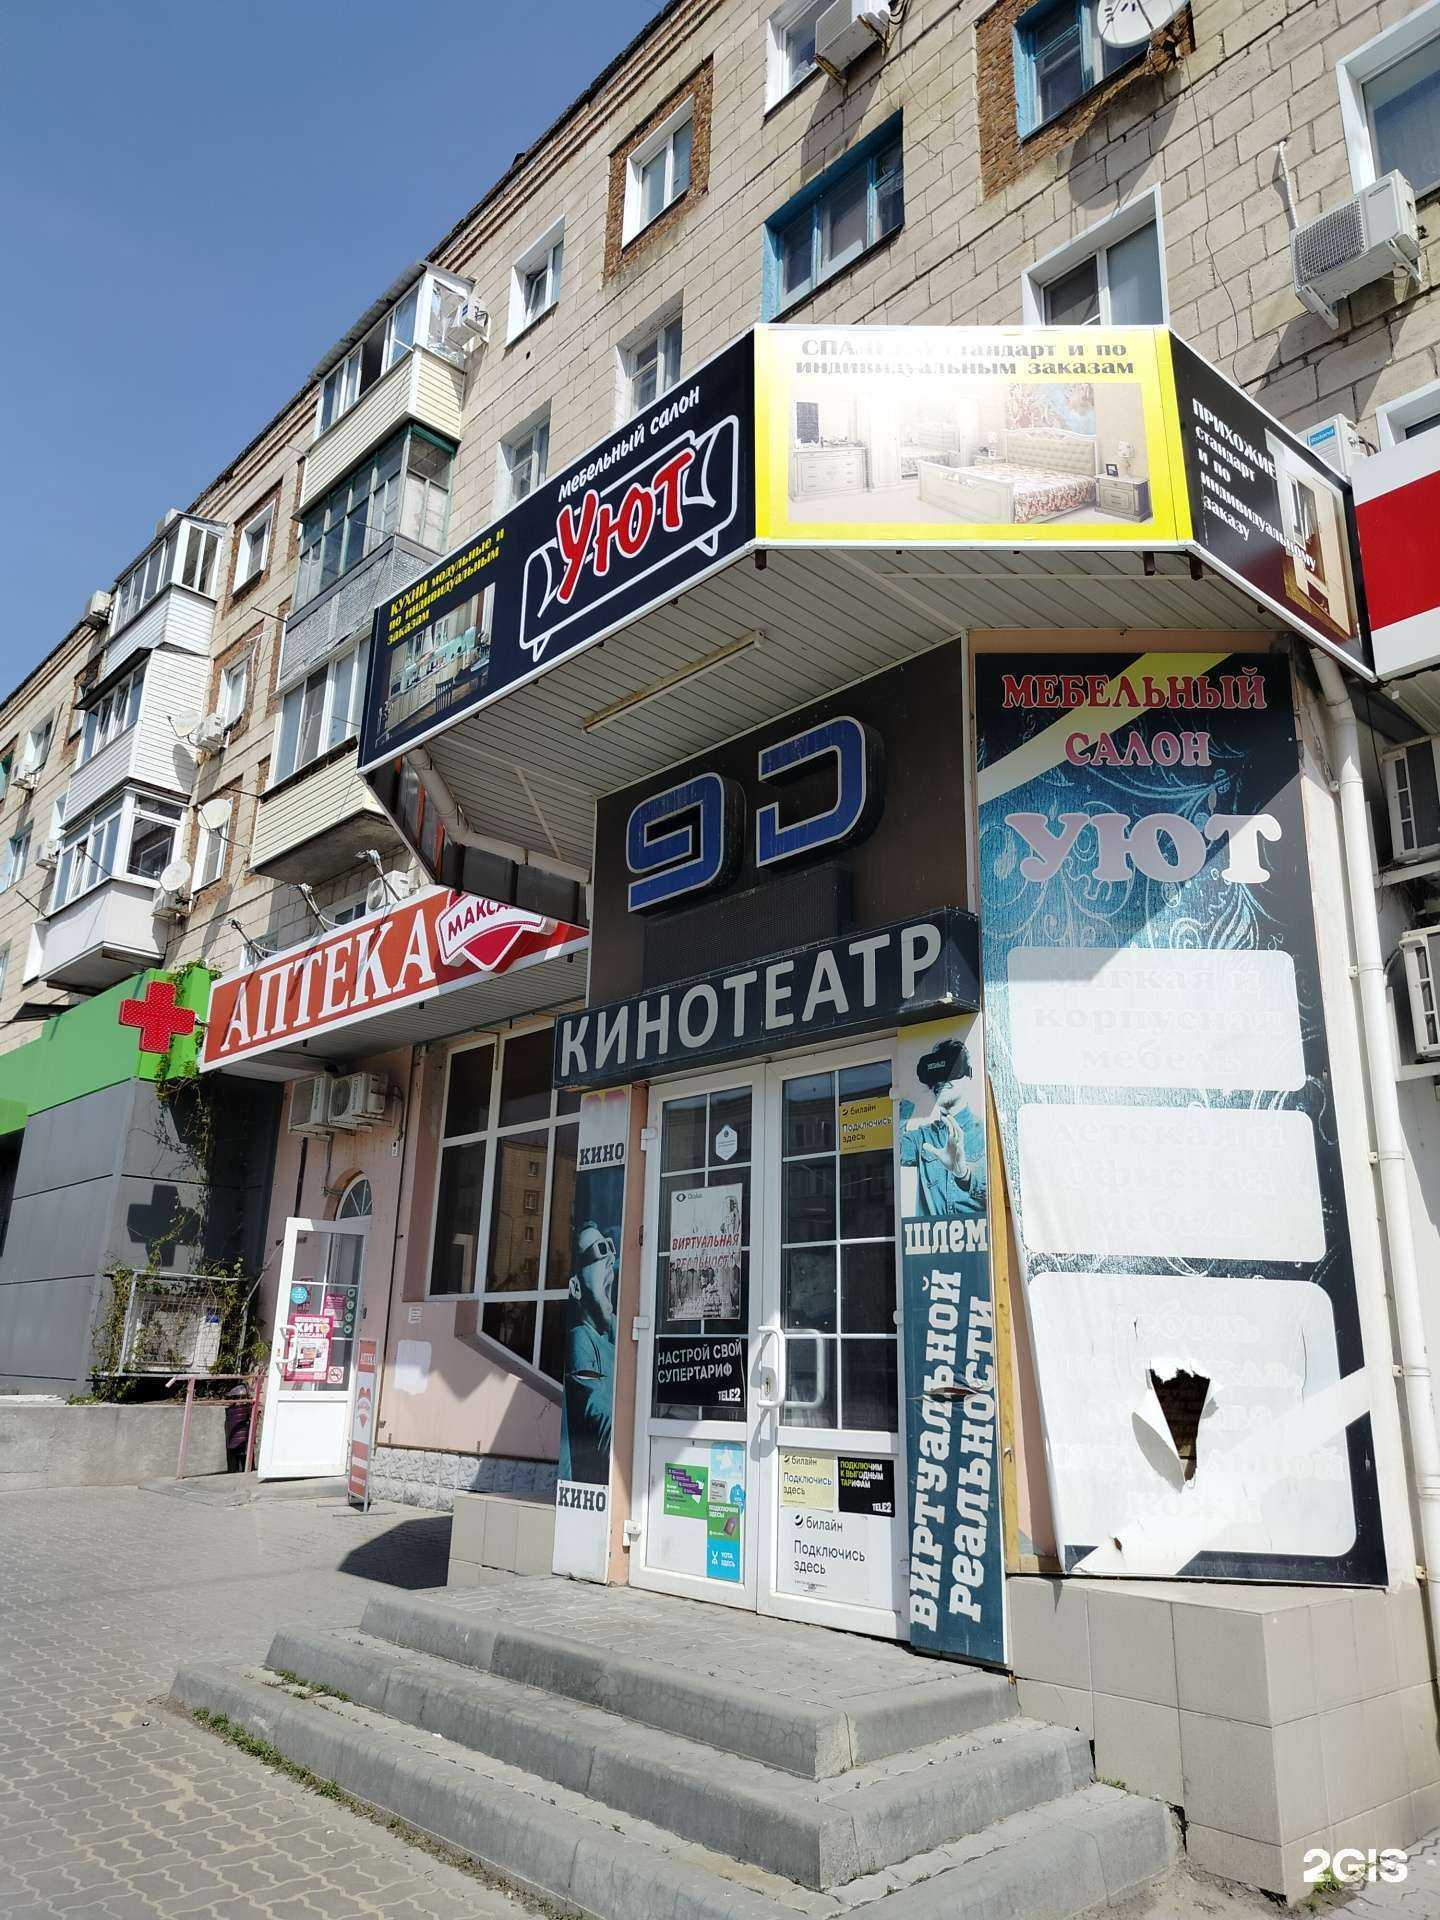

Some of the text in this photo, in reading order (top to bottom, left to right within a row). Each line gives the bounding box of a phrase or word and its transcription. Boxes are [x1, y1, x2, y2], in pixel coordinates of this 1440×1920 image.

[1067, 343, 1085, 356] и
[1096, 343, 1127, 357] по
[1028, 360, 1134, 375] заказам
[650, 386, 700, 435] салон
[1192, 398, 1277, 480] ПРИХОЖИЕ
[1195, 425, 1256, 482] стандарт
[1212, 459, 1231, 483] по
[1201, 472, 1316, 572] индивидуальному
[1203, 496, 1250, 543] заказу
[391, 528, 505, 617] КУХНИ модульные и
[389, 546, 500, 632] по индивидуальным
[387, 609, 430, 645] заказам
[1001, 667, 1267, 709] МЕБЕЛЬНЫЙ
[1064, 731, 1211, 766] САЛОН
[1005, 812, 1282, 884] УЮТ
[220, 908, 437, 1052] АПТЕКА
[560, 923, 942, 1077] КИНОТЕАТР
[1033, 1008, 1283, 1038] корпусная
[1080, 1037, 1243, 1072] мебель
[842, 1116, 892, 1133] Подключись
[842, 1133, 866, 1144] здесь
[579, 1142, 625, 1166] КИНО
[672, 1233, 740, 1251] ВИРТУАЛЬНАЯ
[657, 1338, 743, 1366] НАСТРОЙ СВОЙ
[657, 1362, 732, 1383] СУПЕРТАРИФ
[718, 1388, 741, 1401] TELE2
[792, 1456, 817, 1466] билайн
[840, 1460, 883, 1472] ПОДКЛЮЧИМ
[783, 1472, 832, 1487] Подключись
[841, 1478, 871, 1489] ТАРИФАМ
[846, 1470, 883, 1481] ВЫГОДНЫМ
[558, 1487, 606, 1513] КИНО
[784, 1484, 806, 1496] здесь
[872, 1502, 892, 1513] TELE2
[806, 1515, 843, 1533] билайн
[793, 1539, 866, 1562] Подключись
[793, 1560, 826, 1575] здесь
